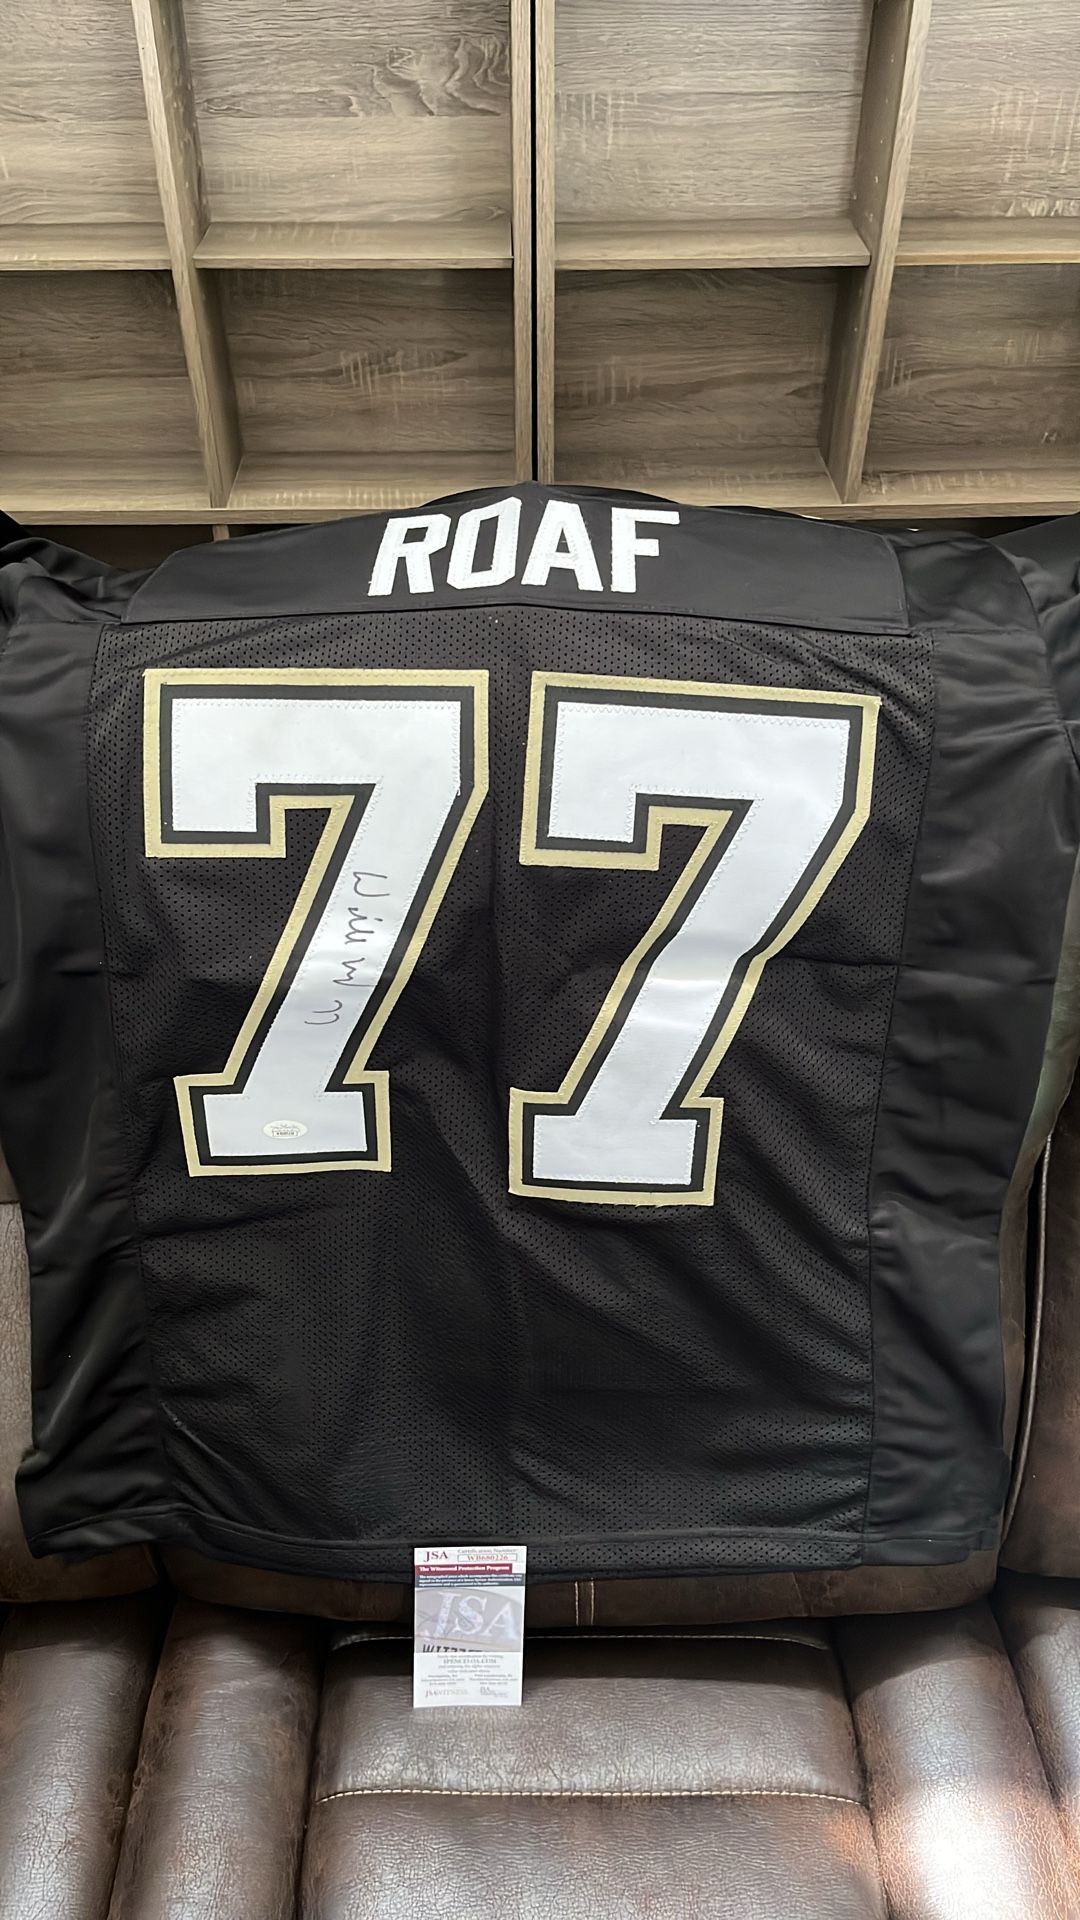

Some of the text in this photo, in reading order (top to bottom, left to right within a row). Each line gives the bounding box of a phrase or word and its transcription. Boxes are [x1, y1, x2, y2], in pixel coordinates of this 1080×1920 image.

[367, 496, 680, 597] ROAF
[142, 667, 882, 1207] 77
[423, 1550, 449, 1563] JSA
[486, 1565, 510, 1573] Program
[424, 1591, 519, 1642] JSA
